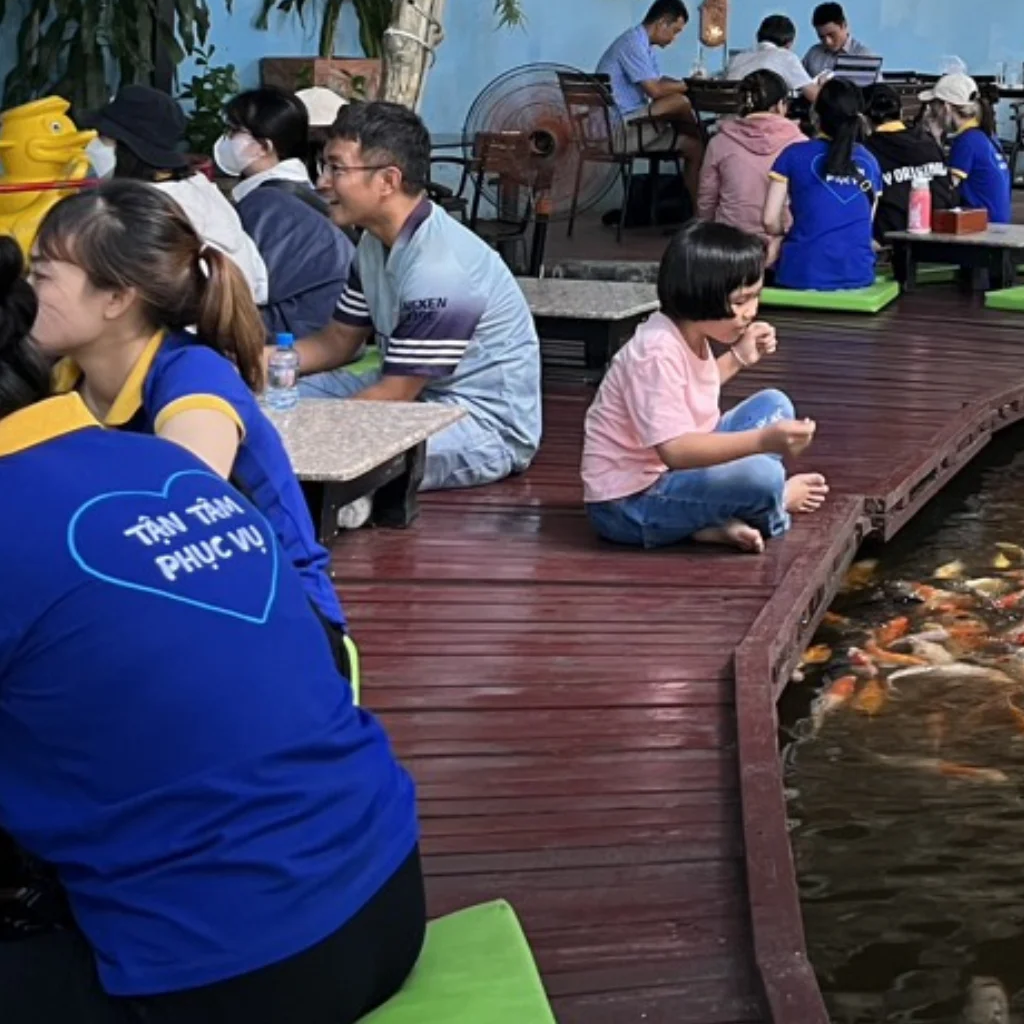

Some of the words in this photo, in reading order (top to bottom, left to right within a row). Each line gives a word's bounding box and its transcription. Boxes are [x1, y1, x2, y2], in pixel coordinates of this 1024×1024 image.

[123, 511, 188, 545] TẬN
[185, 495, 245, 525] TÂM
[154, 535, 233, 581] PHỤC
[227, 524, 267, 554] VỤ
